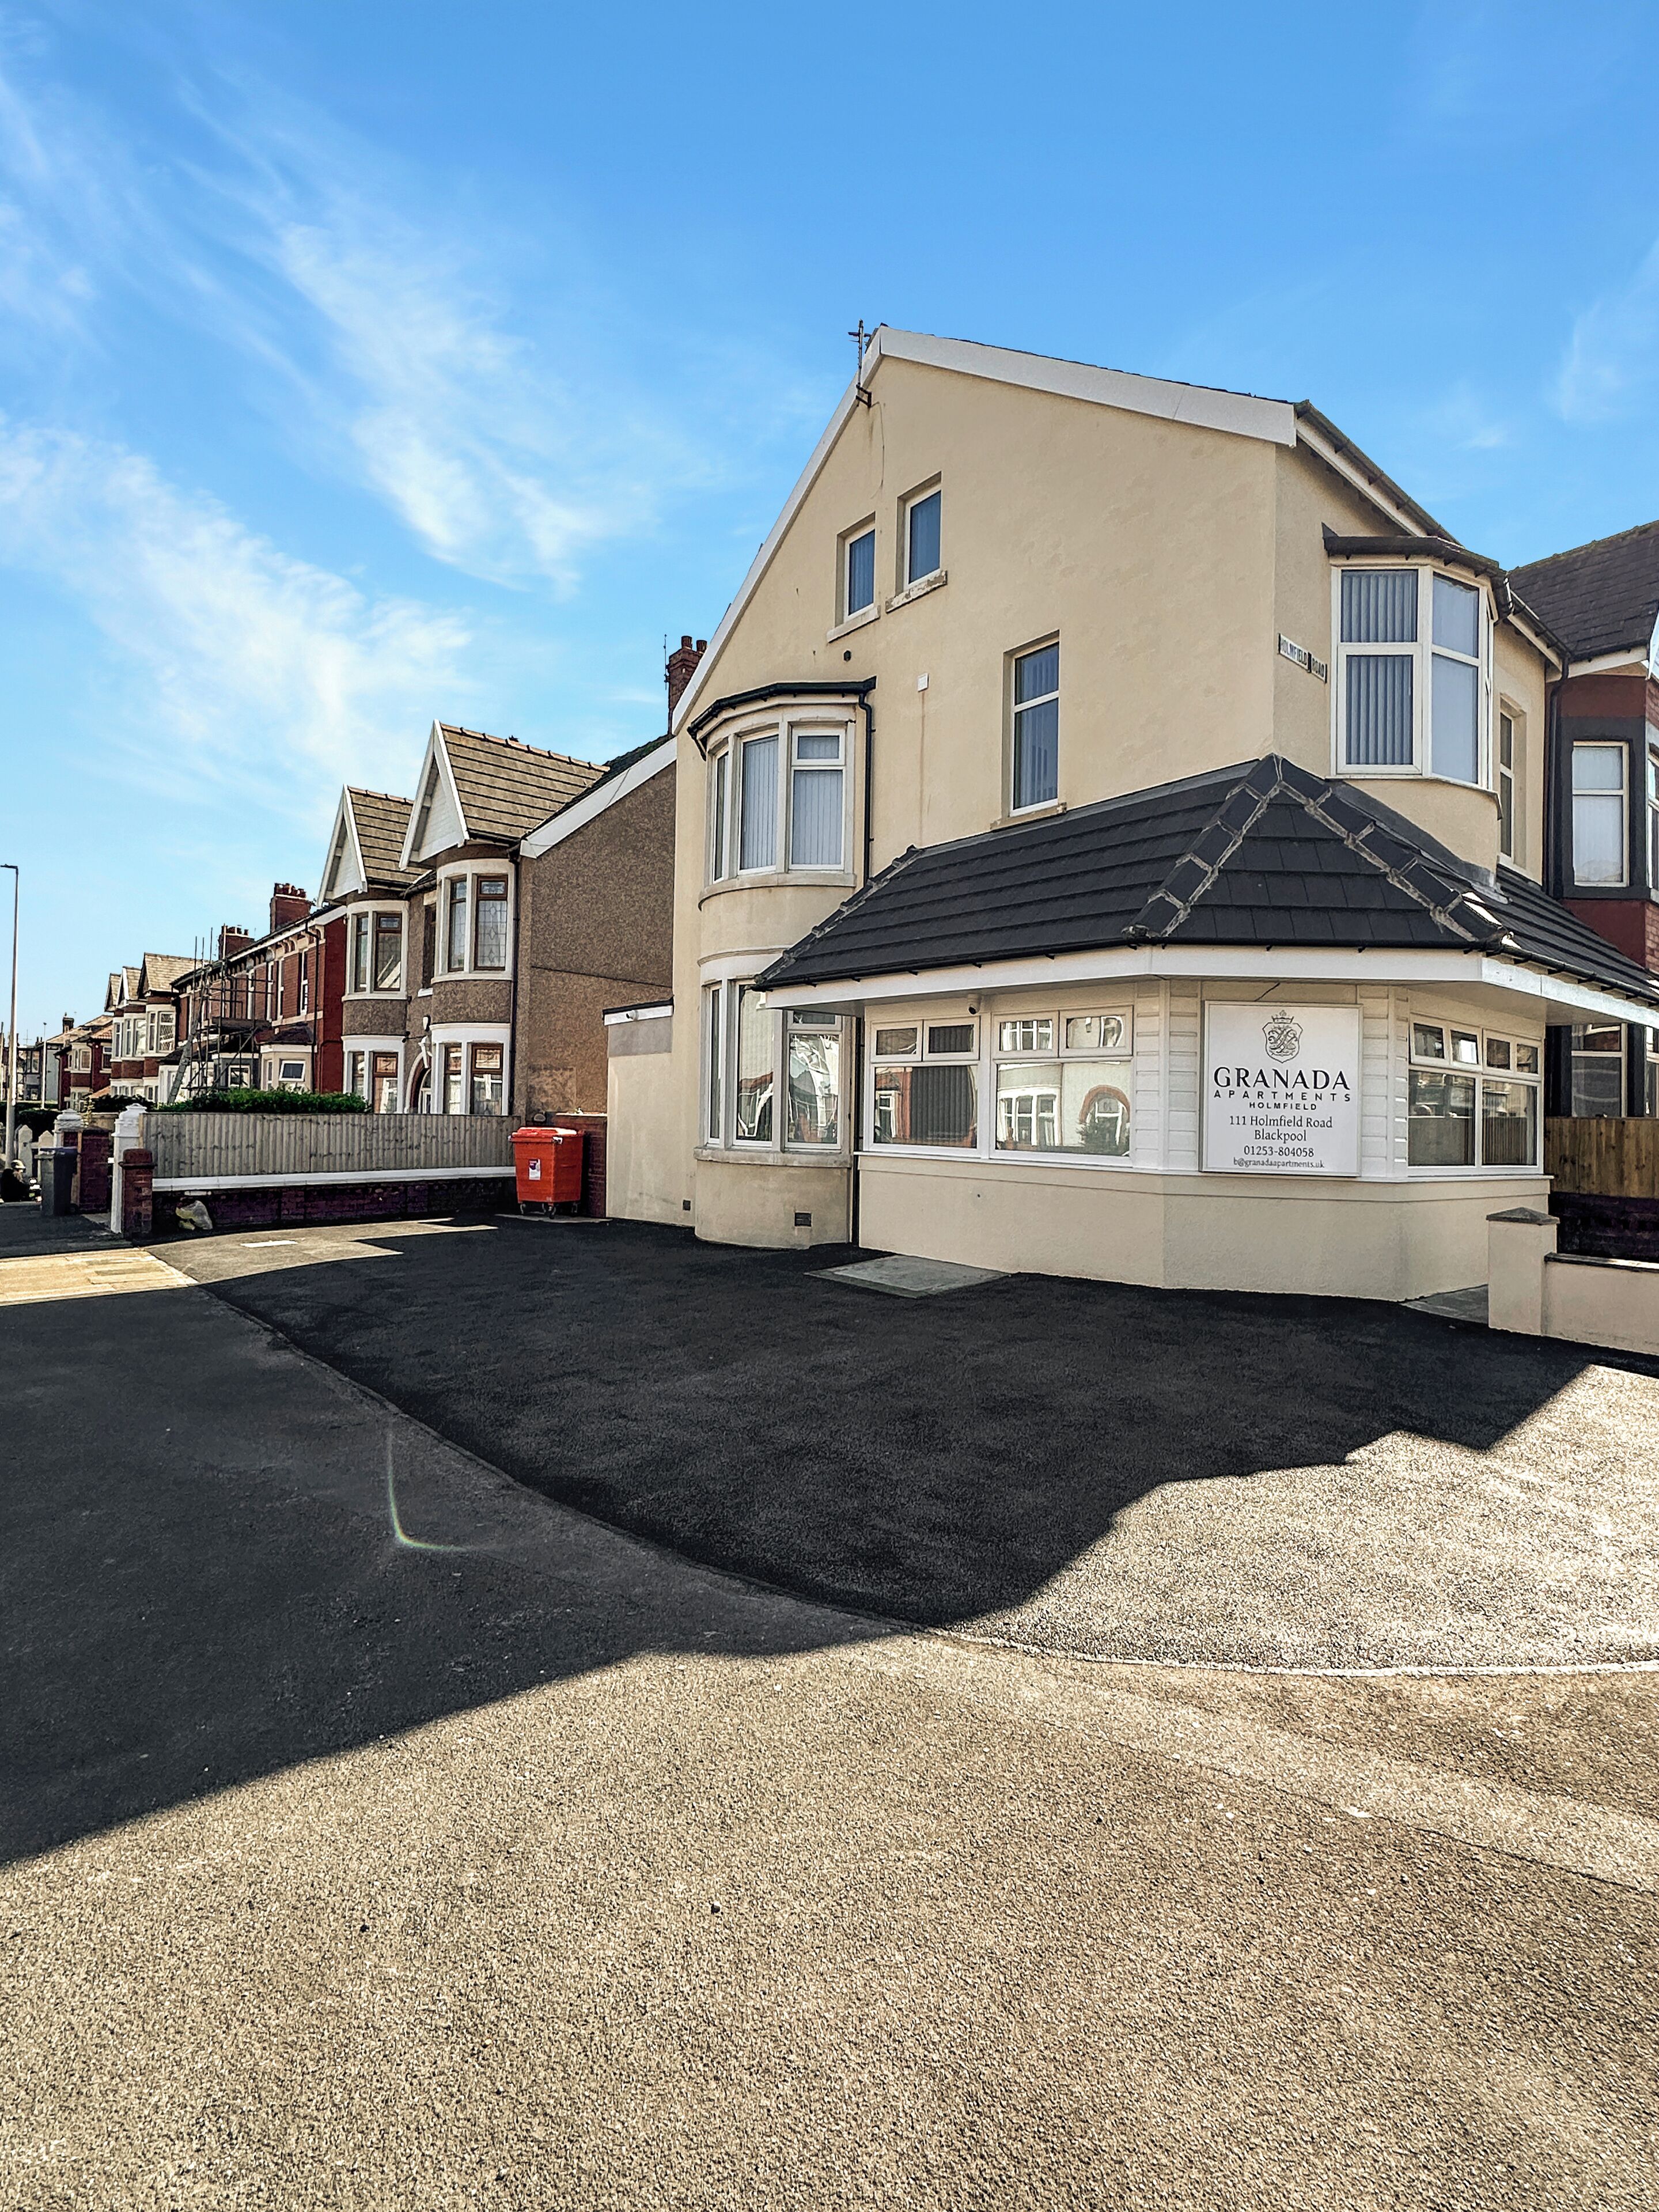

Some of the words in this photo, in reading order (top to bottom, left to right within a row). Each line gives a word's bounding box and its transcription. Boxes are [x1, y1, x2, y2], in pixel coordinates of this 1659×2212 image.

[1214, 1066, 1350, 1090] GRANADA
[1214, 1090, 1350, 1101] APARTMENTS
[1249, 1102, 1317, 1110] HOLMFIELD
[1230, 1115, 1246, 1125] 111
[1251, 1115, 1303, 1127] Holmfield
[1306, 1116, 1332, 1128] Road
[1255, 1128, 1306, 1144] Blackpool
[1244, 1145, 1314, 1157] 01253-804058
